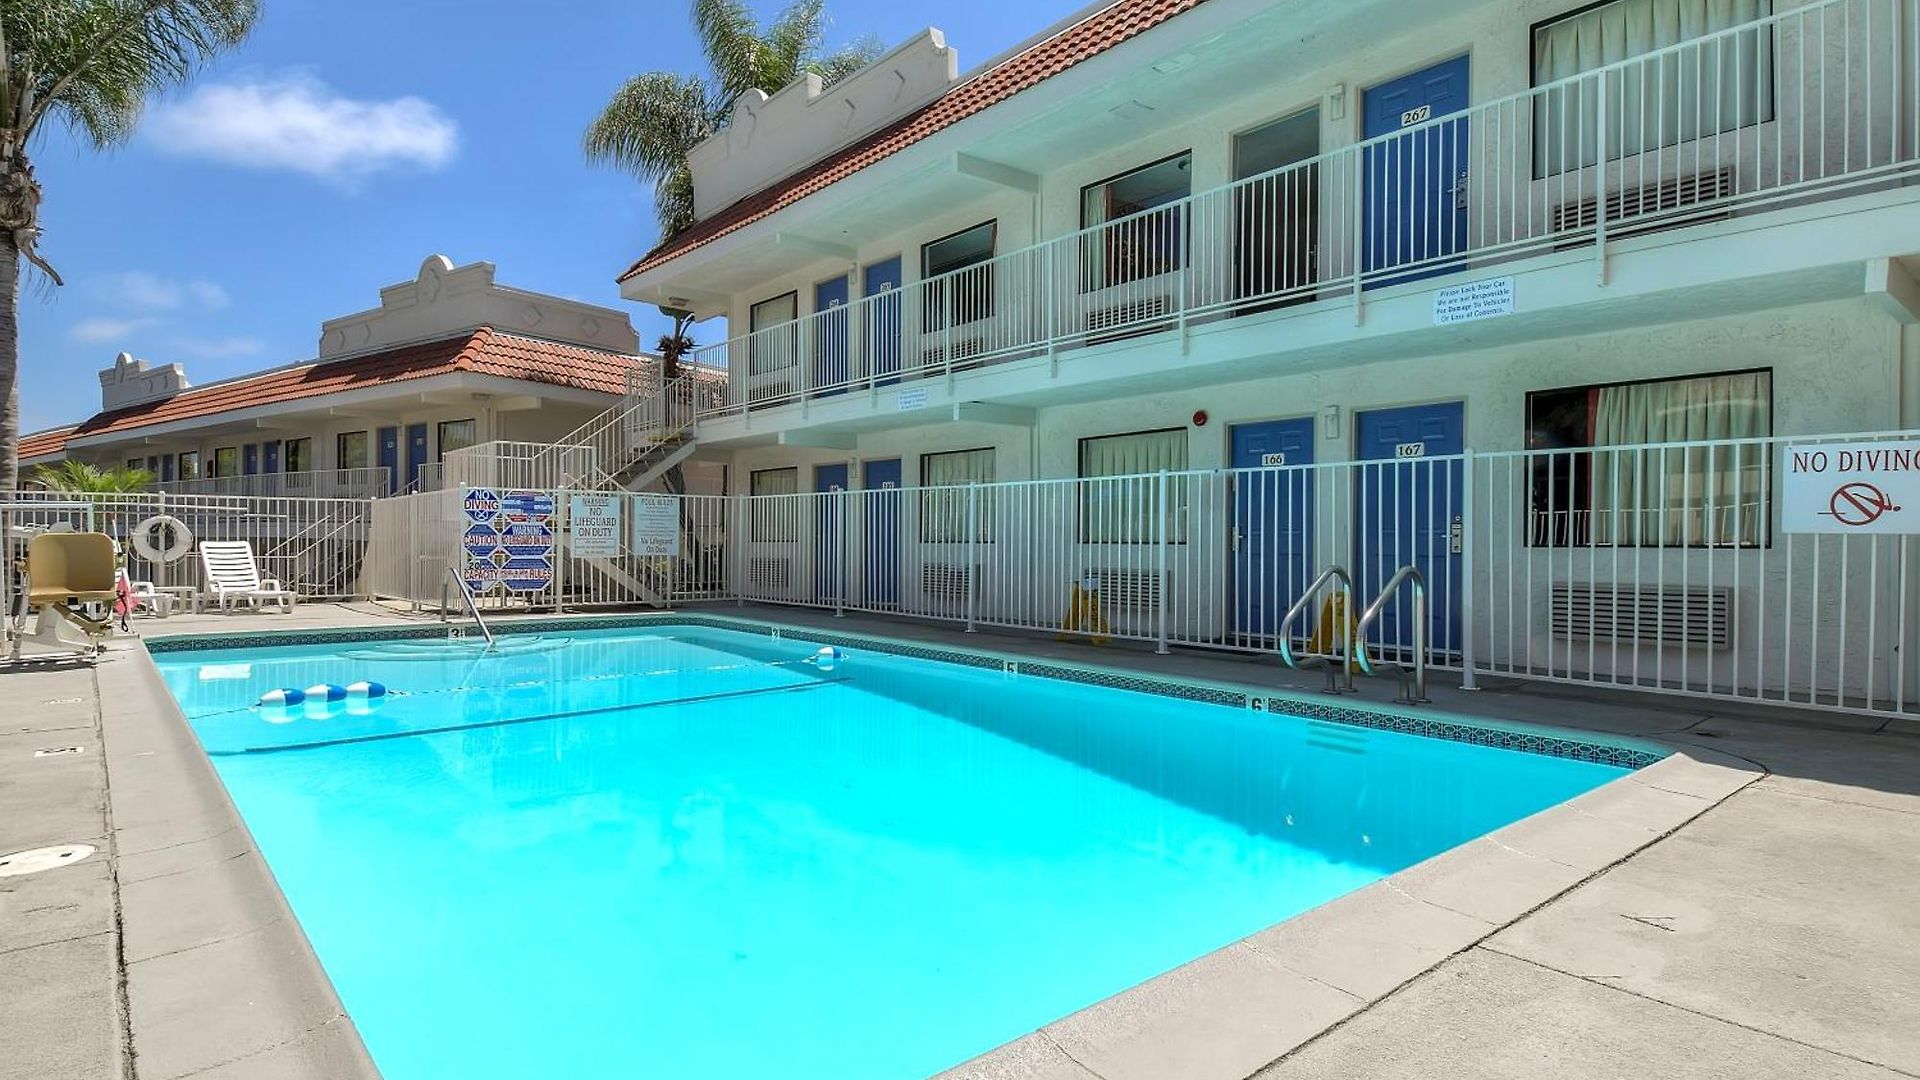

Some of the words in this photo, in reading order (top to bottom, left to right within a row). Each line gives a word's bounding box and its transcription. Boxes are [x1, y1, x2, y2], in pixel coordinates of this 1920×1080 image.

[1404, 106, 1427, 124] 267
[1461, 285, 1475, 293] Lock
[1493, 280, 1505, 288] Car
[1472, 289, 1510, 299] Responsible
[1448, 304, 1471, 313] Damage
[1398, 445, 1421, 456] 167
[1264, 455, 1282, 464] 166
[1792, 451, 1828, 473] NO
[475, 490, 490, 500] NO
[464, 500, 499, 510] DIVING
[589, 507, 602, 516] NO
[574, 517, 617, 527] LIFEGUARD
[512, 525, 542, 535] WARNING
[578, 527, 591, 537] ON
[592, 527, 613, 537] DUTY
[464, 535, 498, 546] CAUTION
[469, 562, 480, 570] 20
[464, 569, 499, 580] CAPACITY
[530, 569, 552, 579] RULES
